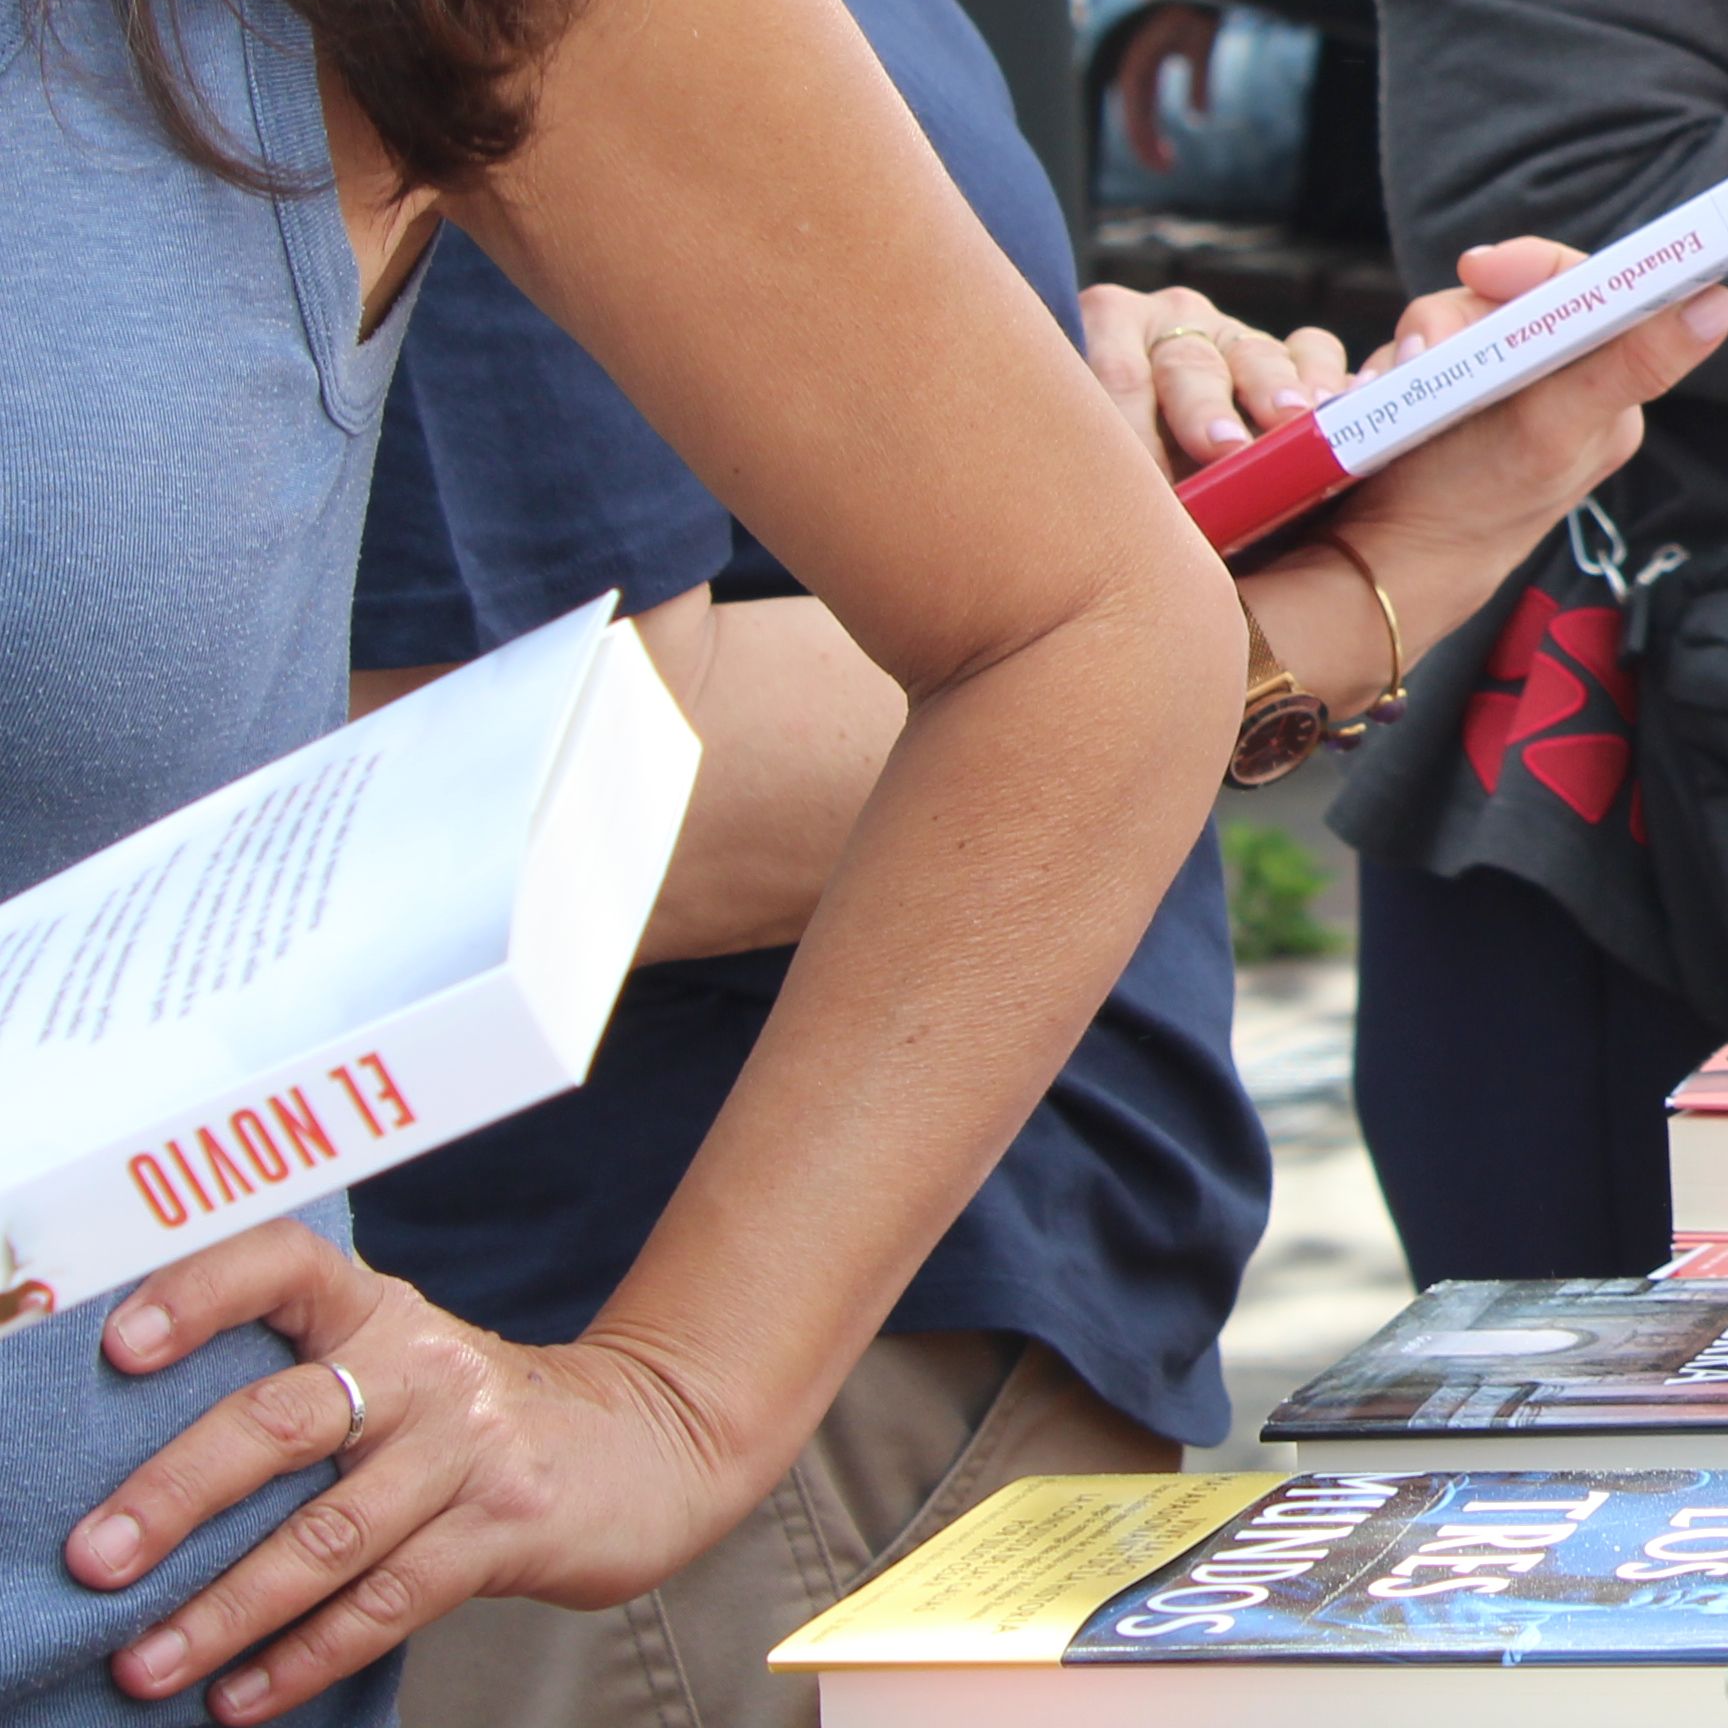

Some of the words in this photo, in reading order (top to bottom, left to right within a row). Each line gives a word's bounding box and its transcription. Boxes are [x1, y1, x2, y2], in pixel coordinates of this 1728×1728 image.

[1606, 229, 1705, 294] Eduardo
[1504, 283, 1607, 351] Mendoza
[1399, 360, 1474, 414] intriga
[1473, 342, 1505, 369] La
[1366, 399, 1403, 434] del
[329, 1049, 419, 1140] EL
[126, 1084, 339, 1229] NOVIO
[1113, 1471, 1424, 1640] MUNDOS
[1367, 1489, 1611, 1600] TRES
